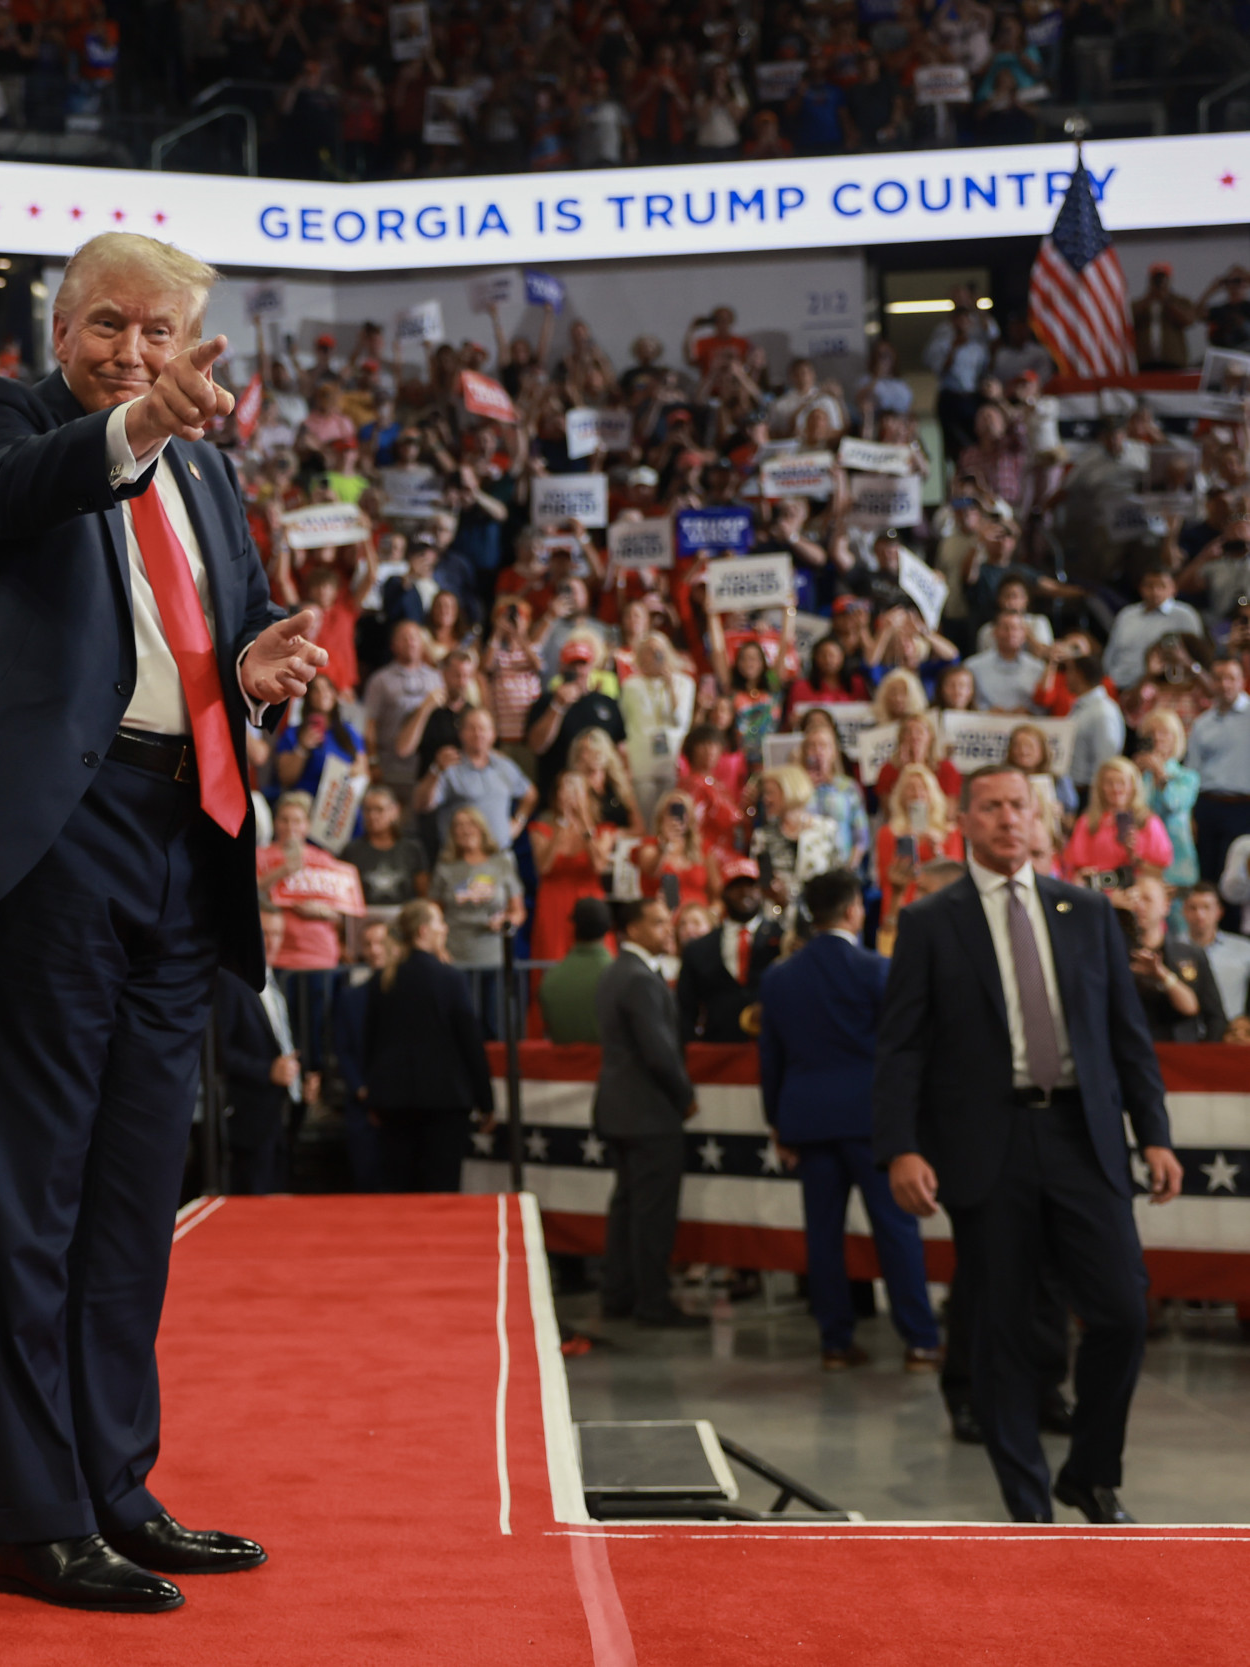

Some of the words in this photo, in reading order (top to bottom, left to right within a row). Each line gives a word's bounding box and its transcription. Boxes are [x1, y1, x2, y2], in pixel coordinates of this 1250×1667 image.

[258, 202, 510, 245] GEORGIA
[536, 194, 583, 234] IS
[607, 186, 806, 230] TRUMP
[830, 165, 1117, 218] COUNTRY
[680, 517, 749, 532] TRUMP
